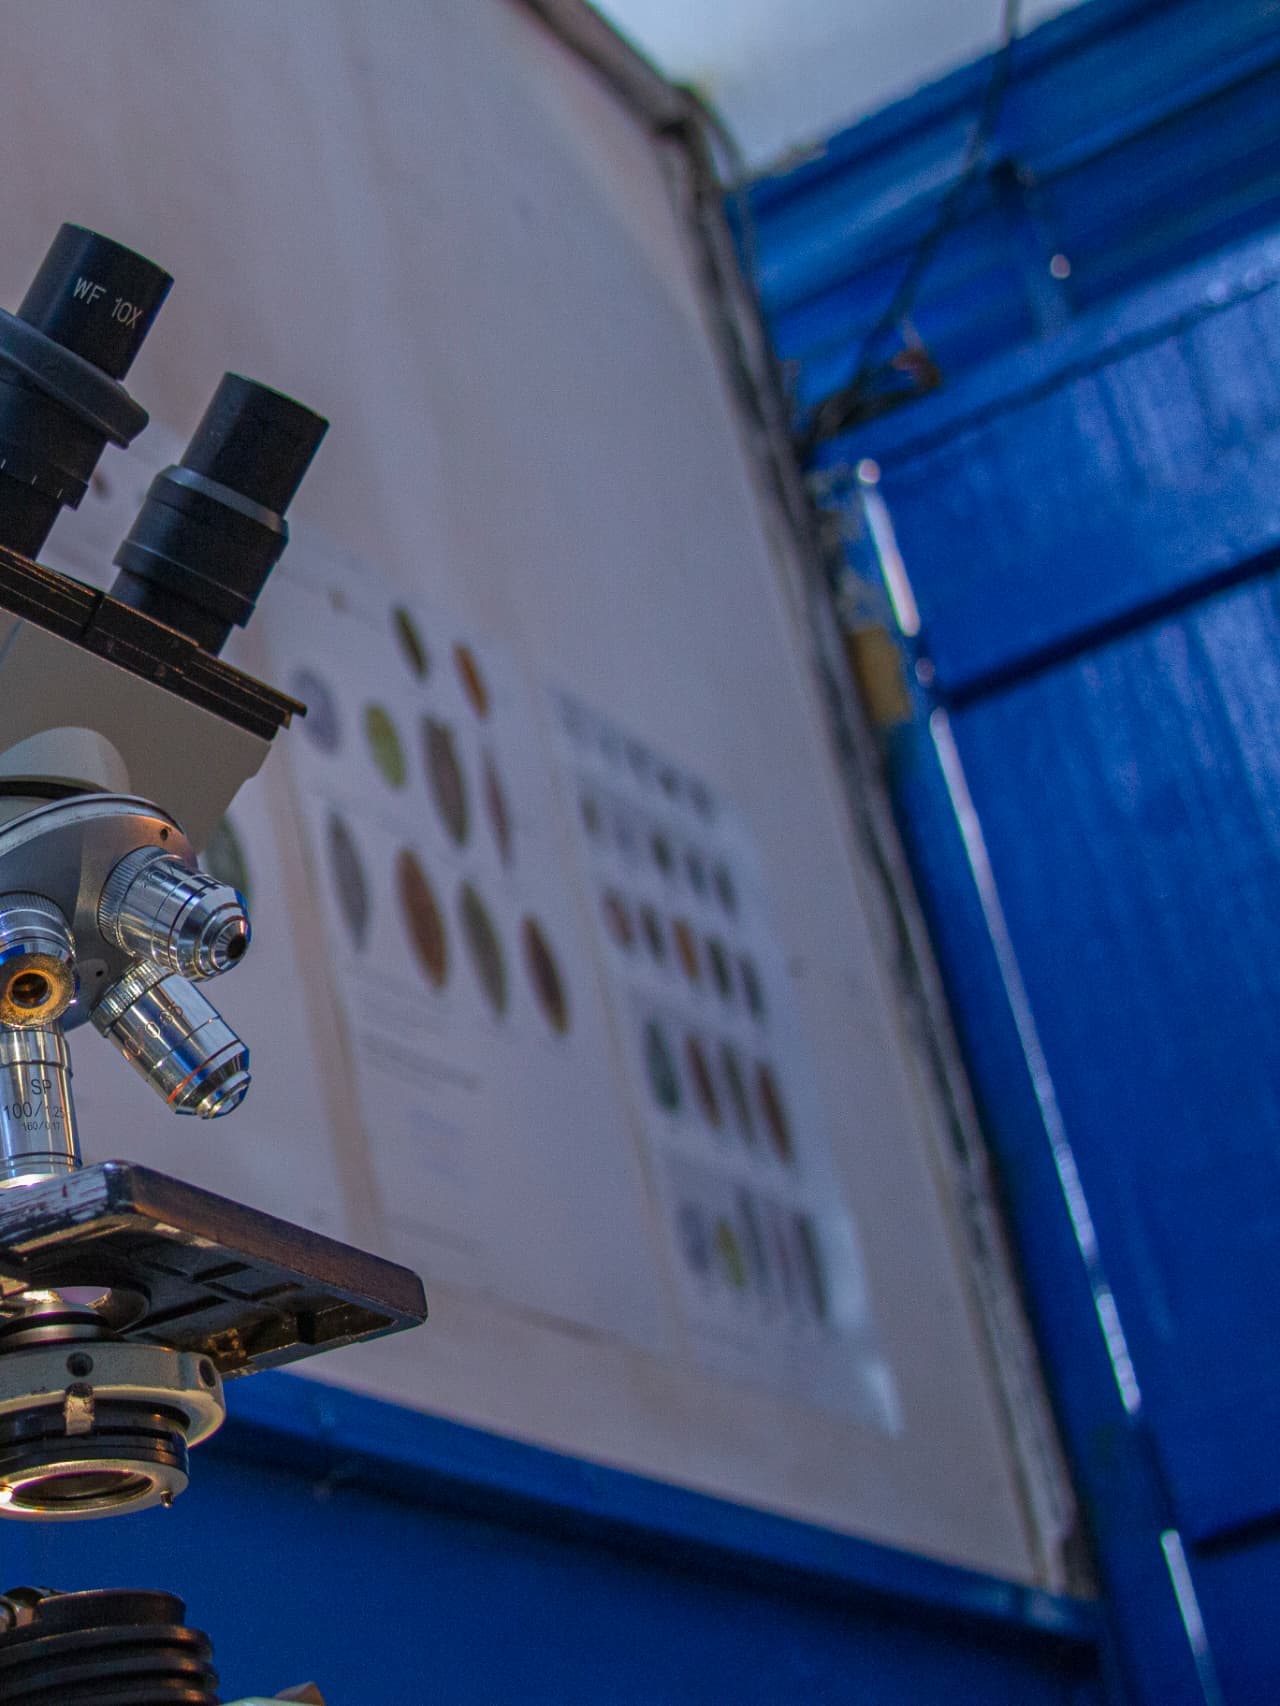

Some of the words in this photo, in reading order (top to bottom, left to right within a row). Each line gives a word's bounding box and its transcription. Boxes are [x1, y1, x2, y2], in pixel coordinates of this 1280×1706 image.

[73, 277, 107, 304] WF
[111, 297, 143, 328] 10X
[31, 1079, 52, 1095] SP
